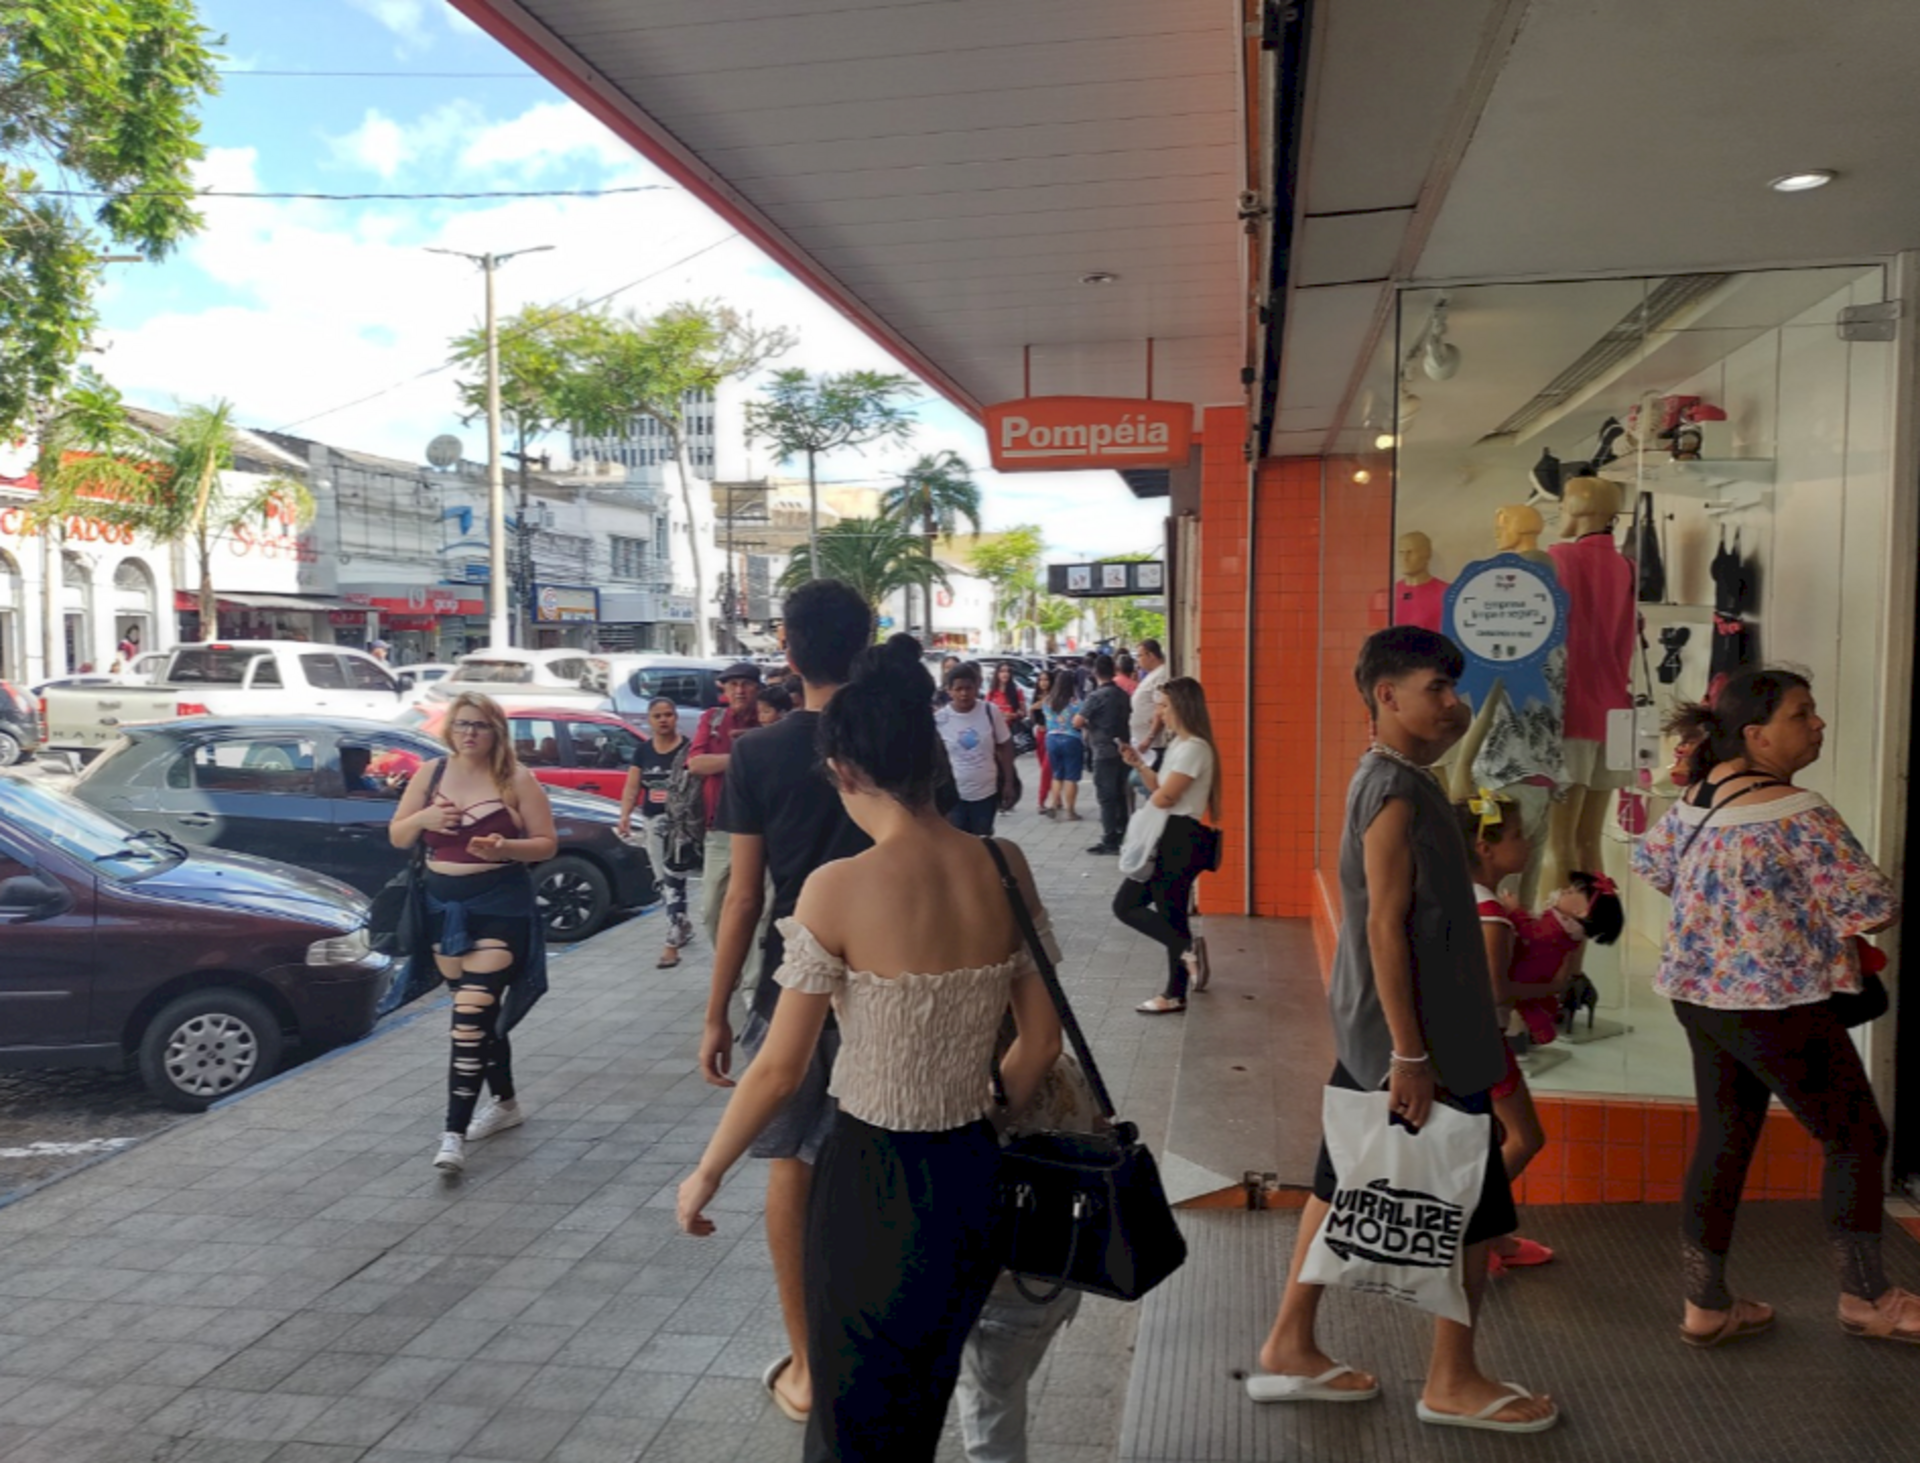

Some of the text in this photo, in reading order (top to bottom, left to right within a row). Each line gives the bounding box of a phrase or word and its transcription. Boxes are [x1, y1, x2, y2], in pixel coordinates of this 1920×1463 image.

[1001, 414, 1169, 455] Pompéia
[1335, 1188, 1463, 1234] VIRALIZE
[1326, 1212, 1458, 1259] MODAS
